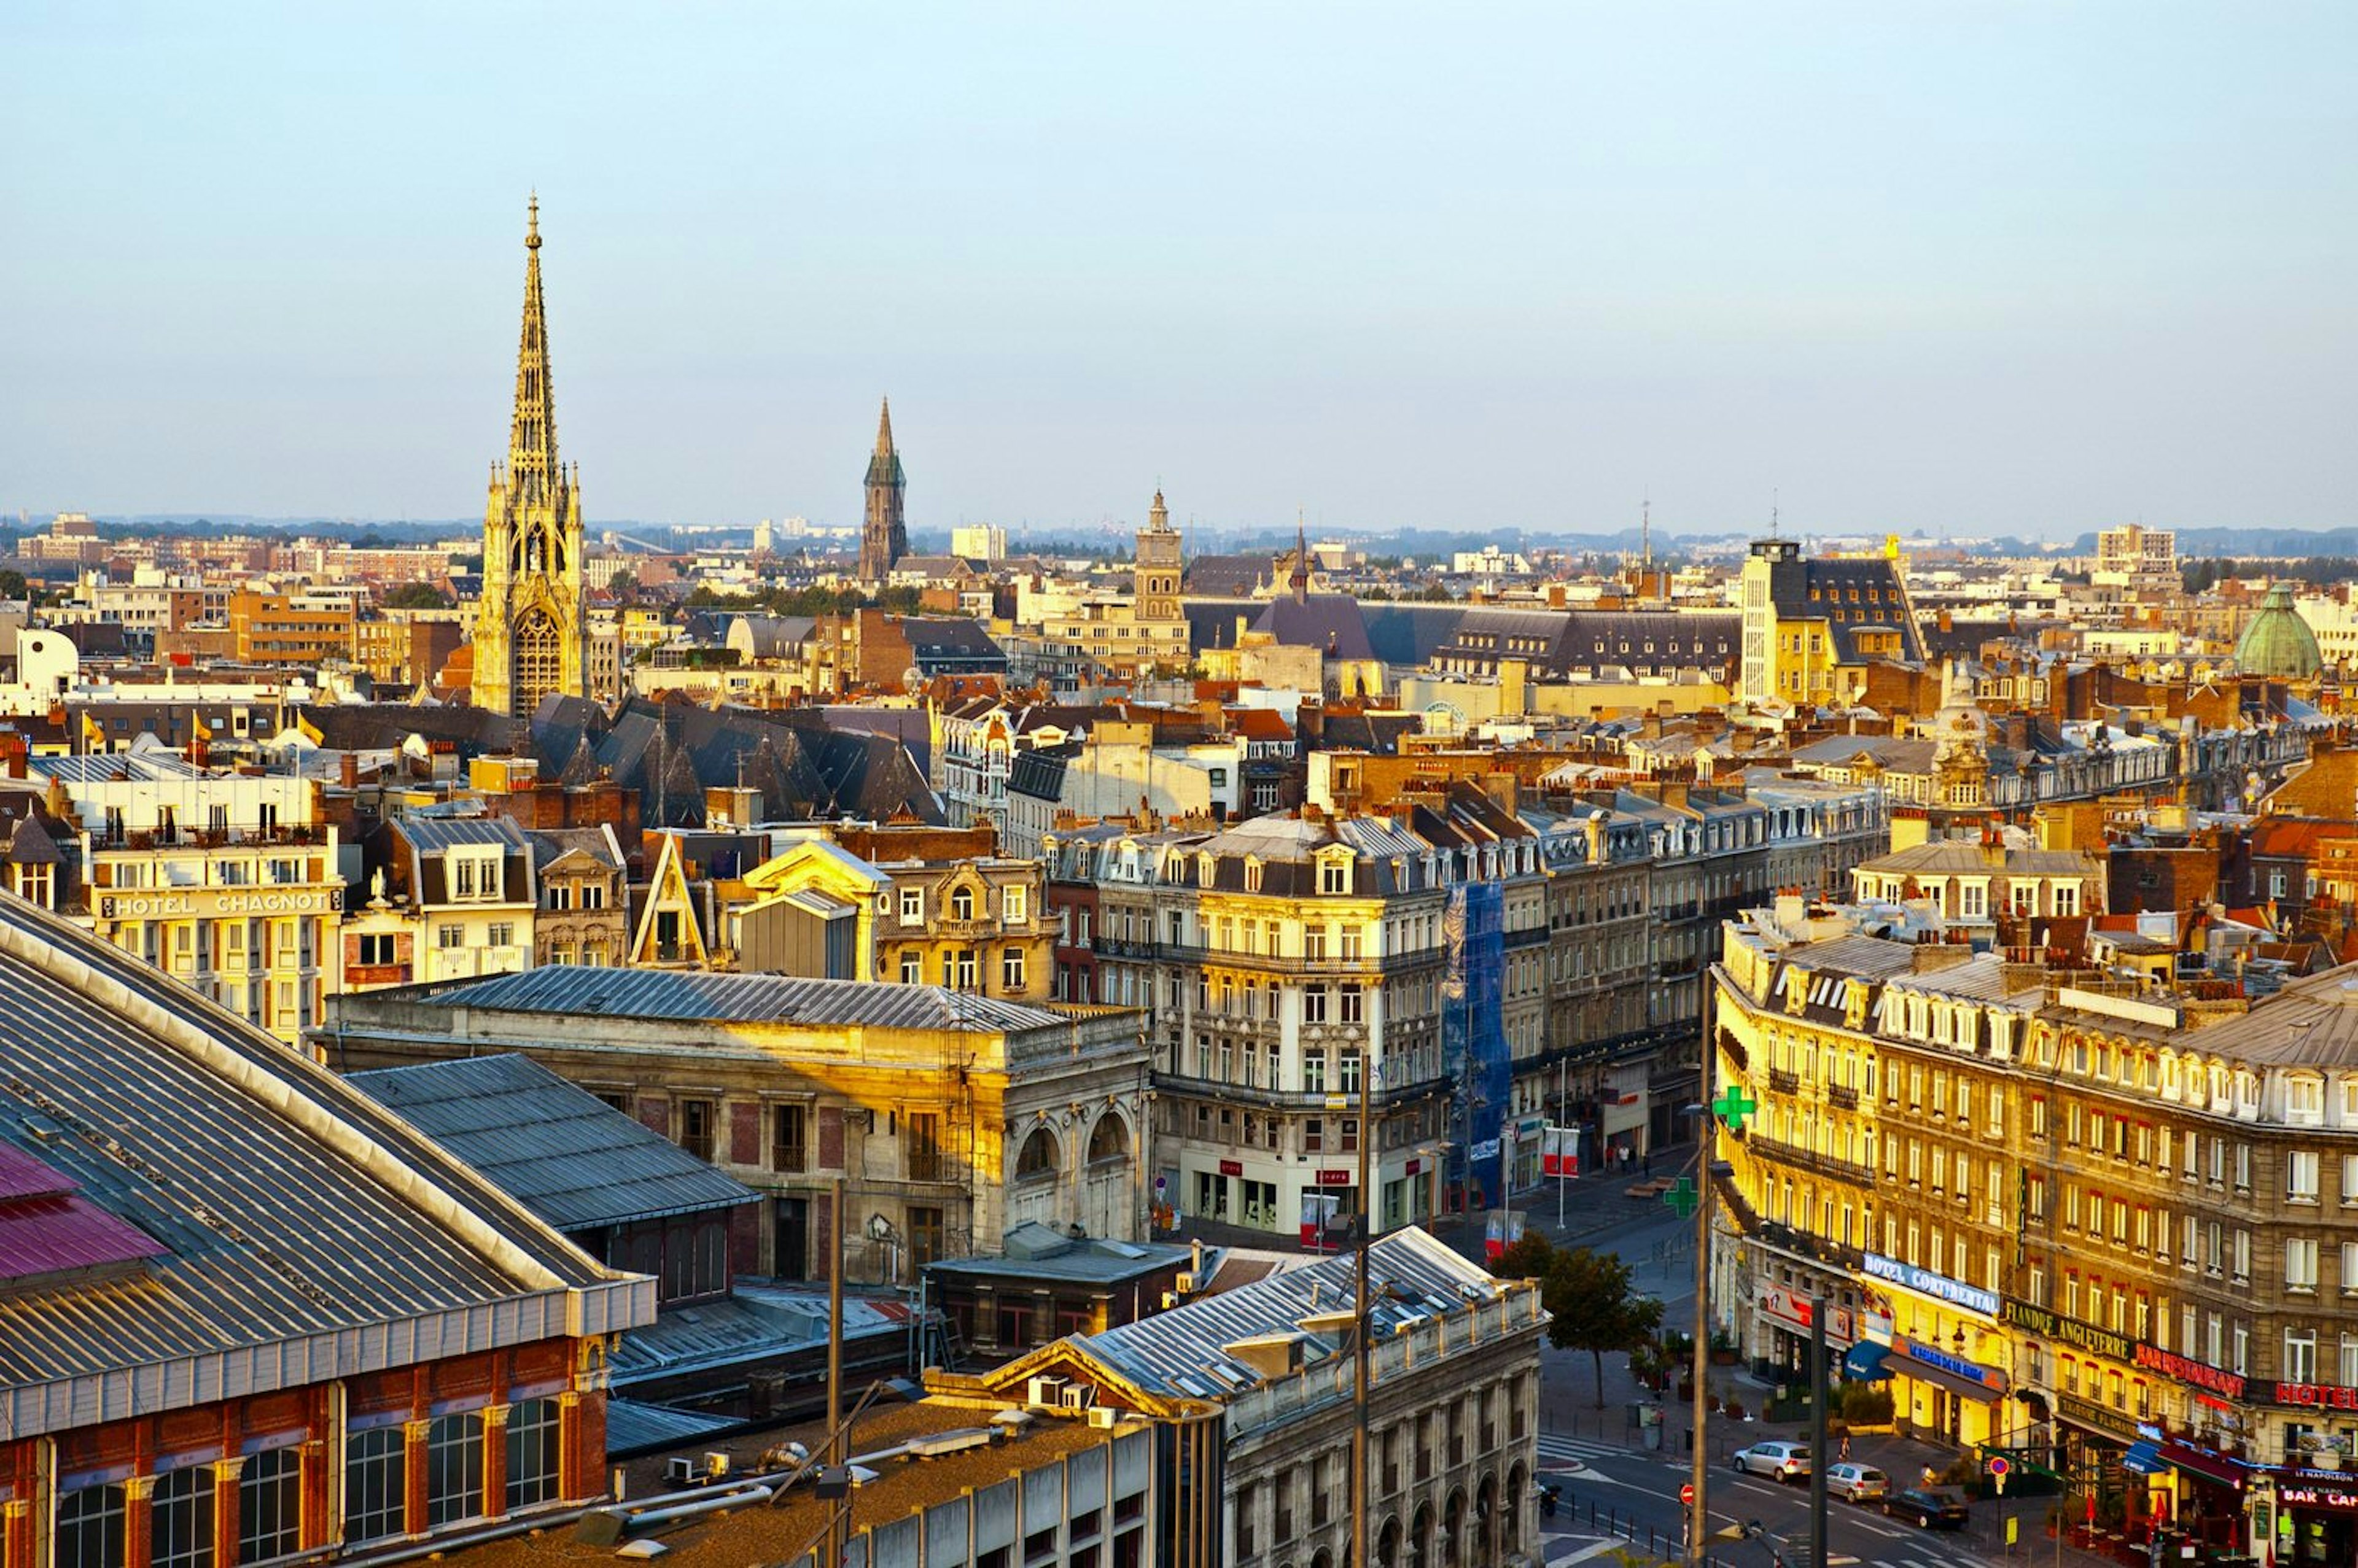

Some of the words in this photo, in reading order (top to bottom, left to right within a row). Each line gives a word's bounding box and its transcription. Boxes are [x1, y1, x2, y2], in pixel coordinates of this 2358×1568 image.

[116, 896, 198, 915] HOTEL
[216, 893, 327, 912] CHAGNOT
[1863, 1254, 1904, 1282] HOTEL
[1912, 1271, 1998, 1313] CONTINENTAL
[2006, 1302, 2053, 1335] FLANDRE
[2059, 1320, 2129, 1359] ANGLETERRE
[2276, 1381, 2358, 1410] HOTEL
[2306, 1472, 2354, 1482] NAPOLEON
[2284, 1490, 2317, 1503] BAR
